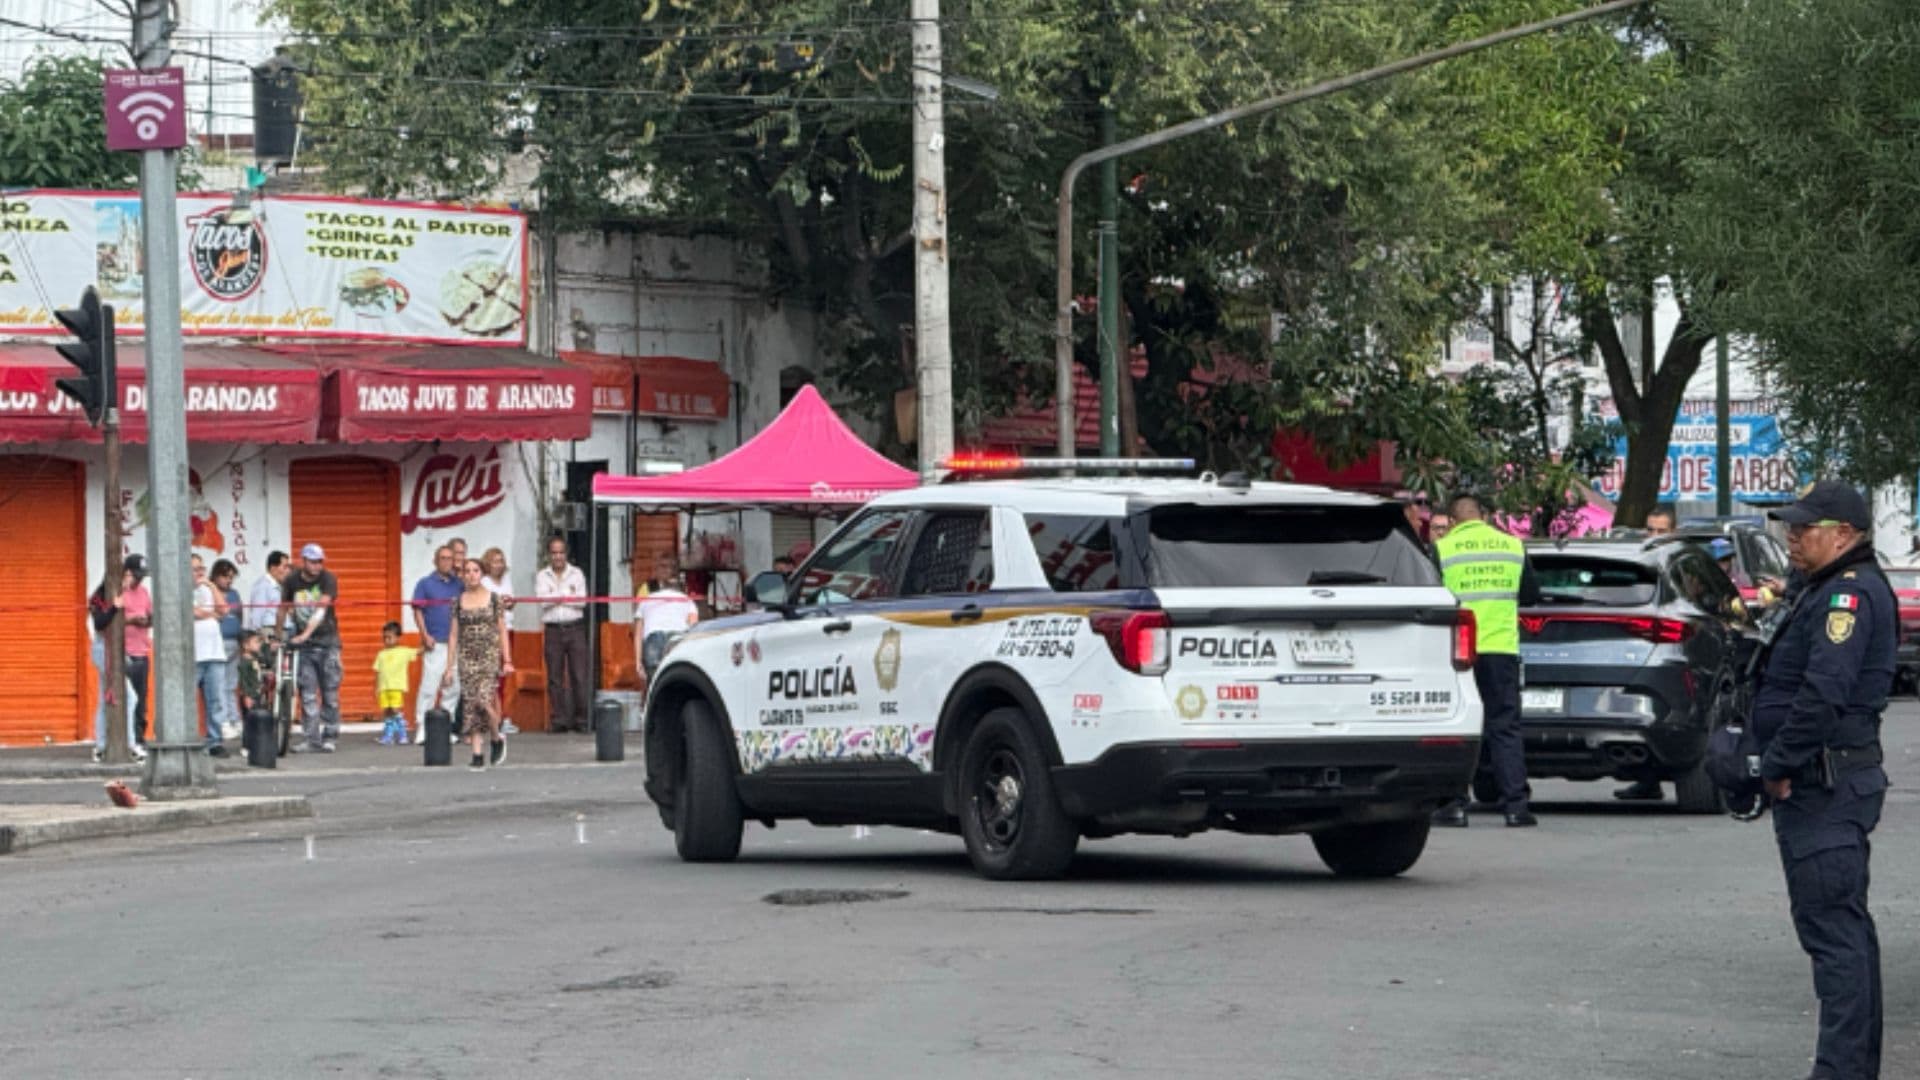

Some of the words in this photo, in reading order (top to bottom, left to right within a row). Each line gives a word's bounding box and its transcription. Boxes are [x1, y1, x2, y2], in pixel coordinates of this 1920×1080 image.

[187, 217, 251, 250] Tacos
[315, 212, 385, 228] TACOS
[392, 217, 421, 232] AL
[427, 220, 513, 238] PASTOR
[316, 228, 415, 247] GRINGAS
[316, 245, 399, 263] TORTAS
[358, 386, 409, 411] TACOS
[413, 385, 458, 411] JUVE
[465, 385, 488, 410] DE
[498, 384, 576, 409] ARANDAS
[1679, 457, 1712, 492] DE
[1729, 457, 1798, 492] AROS
[400, 444, 506, 536] Lulú
[1464, 565, 1505, 575] CENTRO
[1006, 617, 1083, 638] TLATELOLCO
[1179, 630, 1278, 659] POLICÍA
[769, 653, 857, 700] POLICÍA
[1370, 692, 1387, 705] 55
